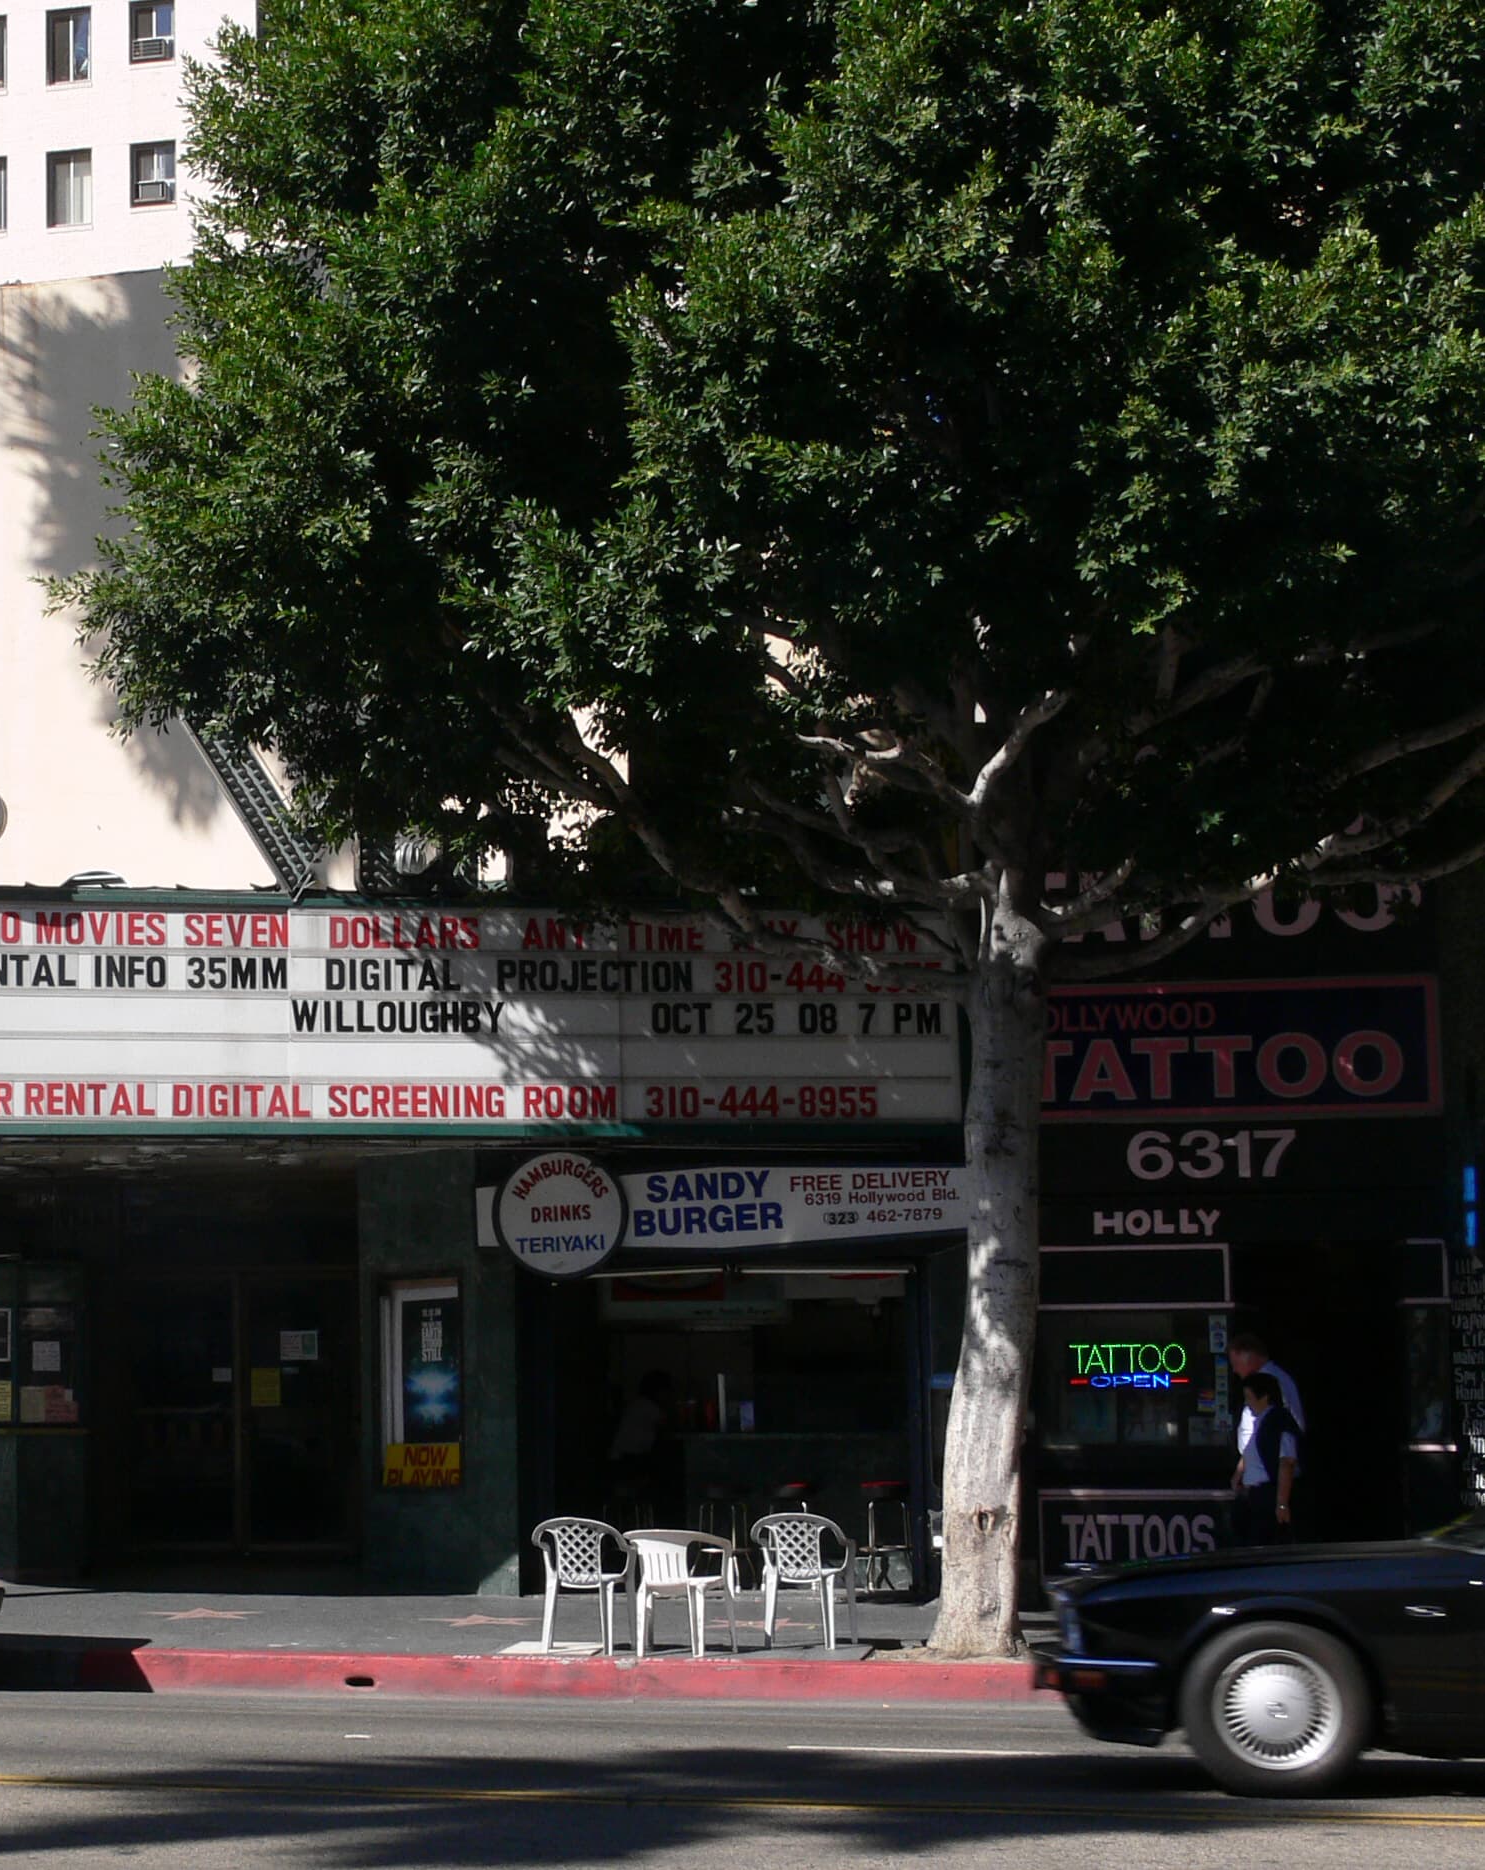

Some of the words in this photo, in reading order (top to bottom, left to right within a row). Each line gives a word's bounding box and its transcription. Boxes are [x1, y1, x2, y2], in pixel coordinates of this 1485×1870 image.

[36, 911, 165, 946] MOVIES
[184, 913, 289, 947] SEVEN
[329, 916, 480, 949] DOLLARS
[522, 917, 586, 950] ANY
[627, 921, 705, 951] TIME
[95, 955, 167, 988] INFO
[187, 957, 288, 990] 35MM
[326, 959, 461, 992] DIGITAL
[497, 960, 693, 993] PROJECTION
[292, 999, 506, 1033] WILLOUGHBY
[651, 1003, 712, 1034] OCT
[735, 1003, 775, 1034] 25
[798, 1003, 838, 1034] 08
[858, 1003, 875, 1034] 7
[893, 1003, 942, 1034] PM
[1046, 1001, 1215, 1033] OLLYWOOD
[1041, 1030, 1404, 1101] TATTOO
[25, 1083, 156, 1116] RENTAL
[172, 1084, 312, 1117] DIGITAL
[328, 1085, 505, 1118] SCREENING
[524, 1085, 617, 1118] ROOM
[646, 1086, 878, 1118] 310-444-8955
[1126, 1129, 1296, 1180] 6317
[512, 1159, 609, 1200] HAMBURGERS
[646, 1170, 770, 1203] SANDY
[790, 1174, 842, 1192] FREE
[852, 1170, 950, 1190] DELIVERY
[531, 1204, 591, 1223] DRINKS
[804, 1193, 842, 1206] 6319
[849, 1189, 925, 1205] Hollywood
[633, 1202, 784, 1237] BURGER
[823, 1211, 859, 1225] (323)
[866, 1208, 943, 1222] 462-7879
[1092, 1208, 1221, 1237] HOLLY
[515, 1234, 606, 1254] TERIYAKI
[1068, 1343, 1187, 1375] TATTOO
[1090, 1373, 1171, 1390] OPEN
[404, 1445, 449, 1467] NOW
[1061, 1514, 1215, 1561] TATTOOS
